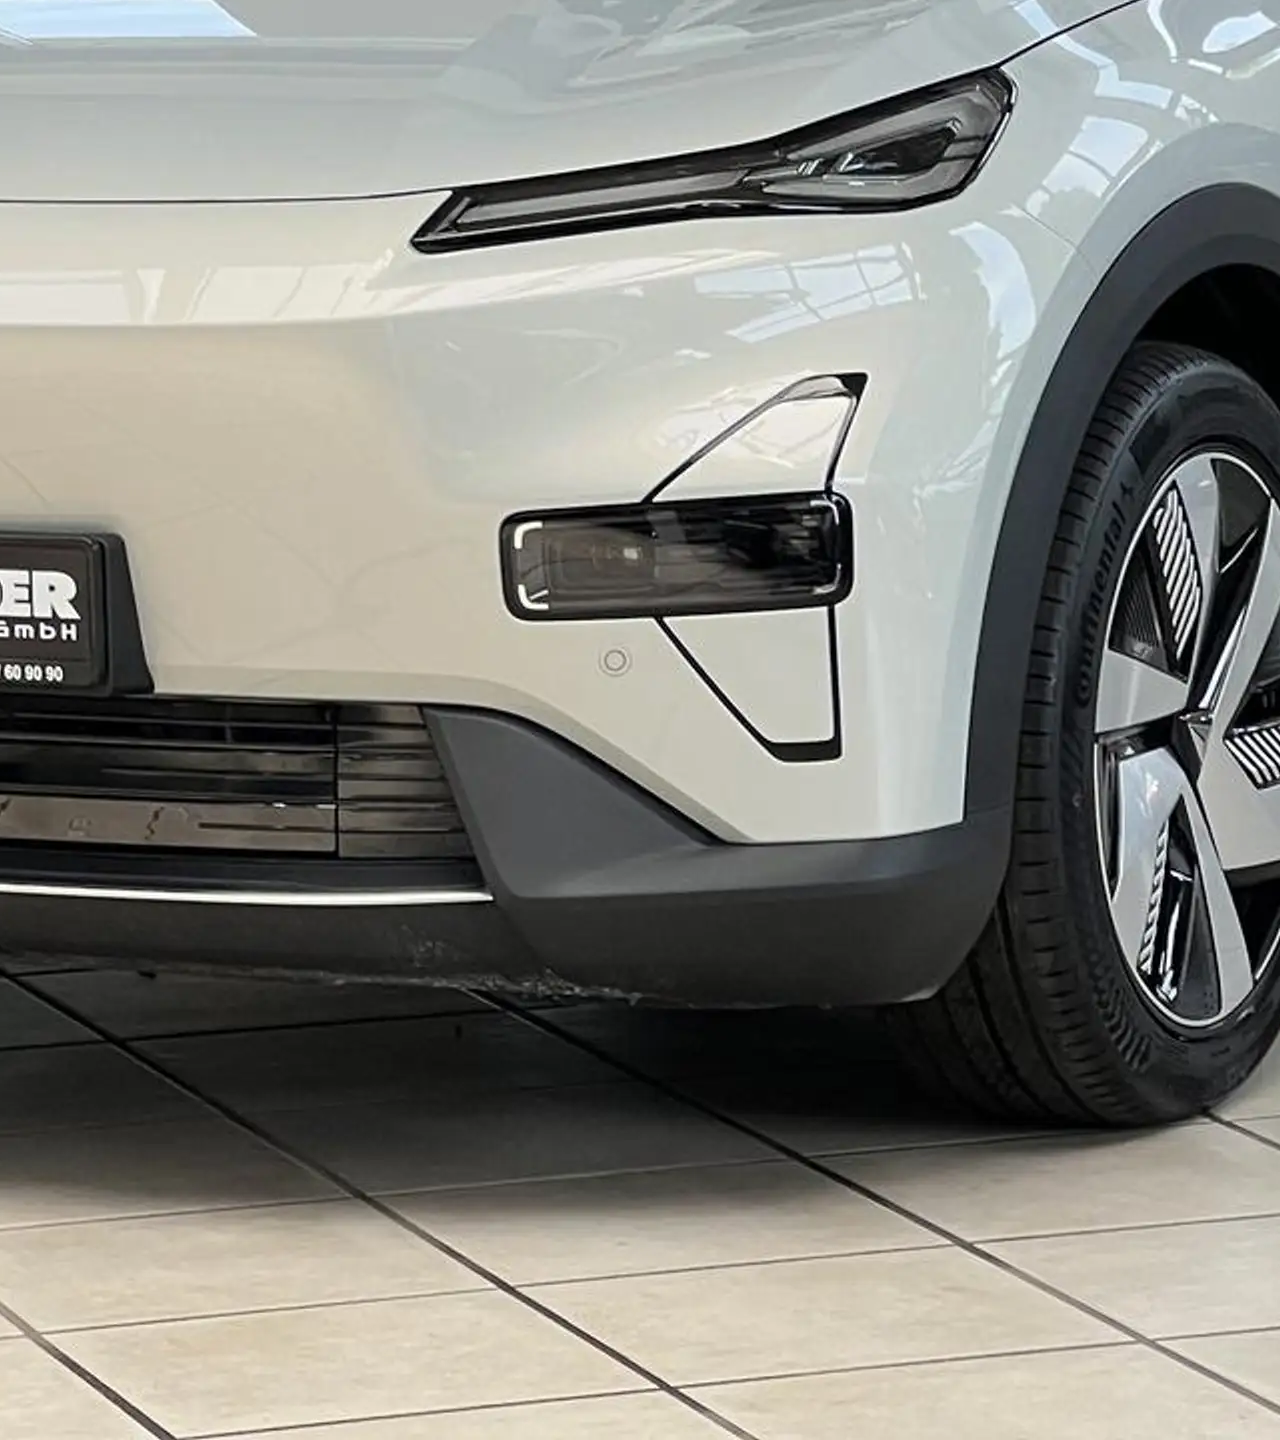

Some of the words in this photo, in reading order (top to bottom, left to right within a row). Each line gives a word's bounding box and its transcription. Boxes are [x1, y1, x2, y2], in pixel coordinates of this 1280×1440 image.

[3, 663, 22, 681] 60
[24, 665, 43, 682] 90
[45, 665, 64, 683] 90
